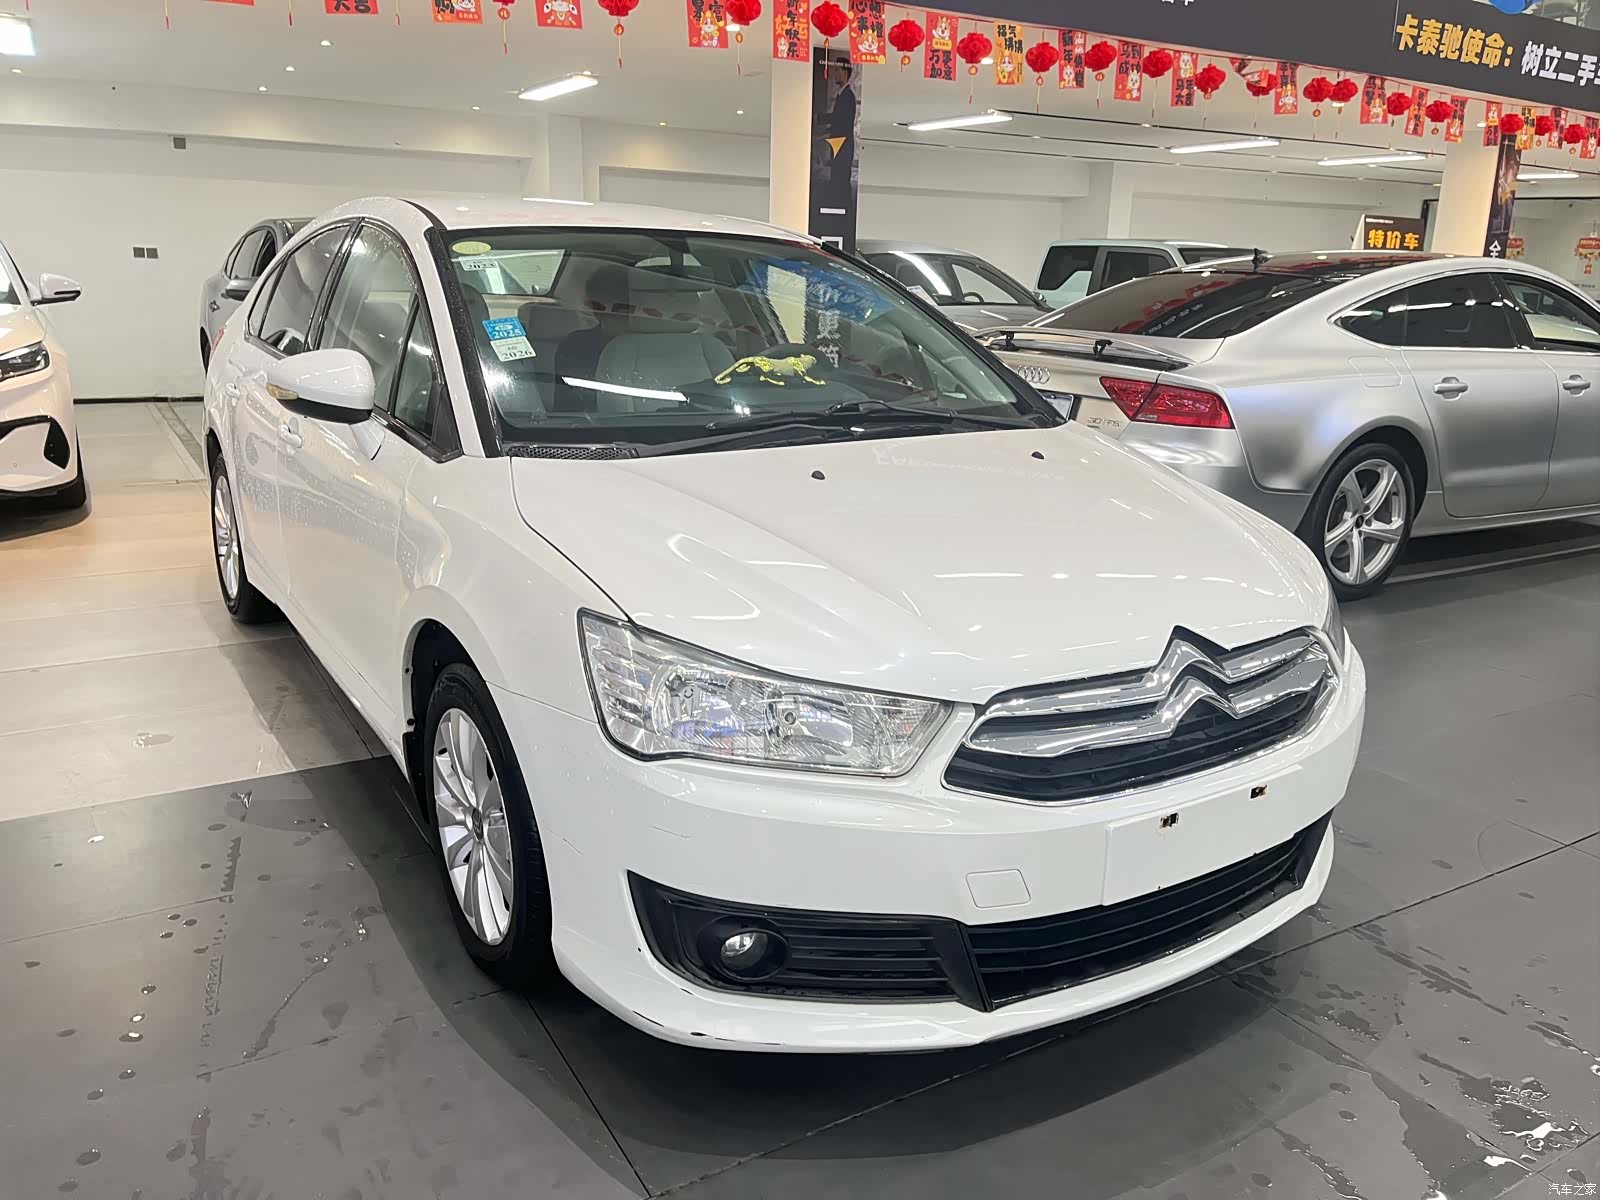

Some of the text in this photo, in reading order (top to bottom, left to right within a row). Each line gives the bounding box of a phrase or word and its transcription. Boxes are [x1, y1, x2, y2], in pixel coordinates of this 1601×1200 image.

[1367, 229, 1420, 250] 特价车
[491, 328, 522, 339] 2025
[501, 350, 533, 360] 2026
